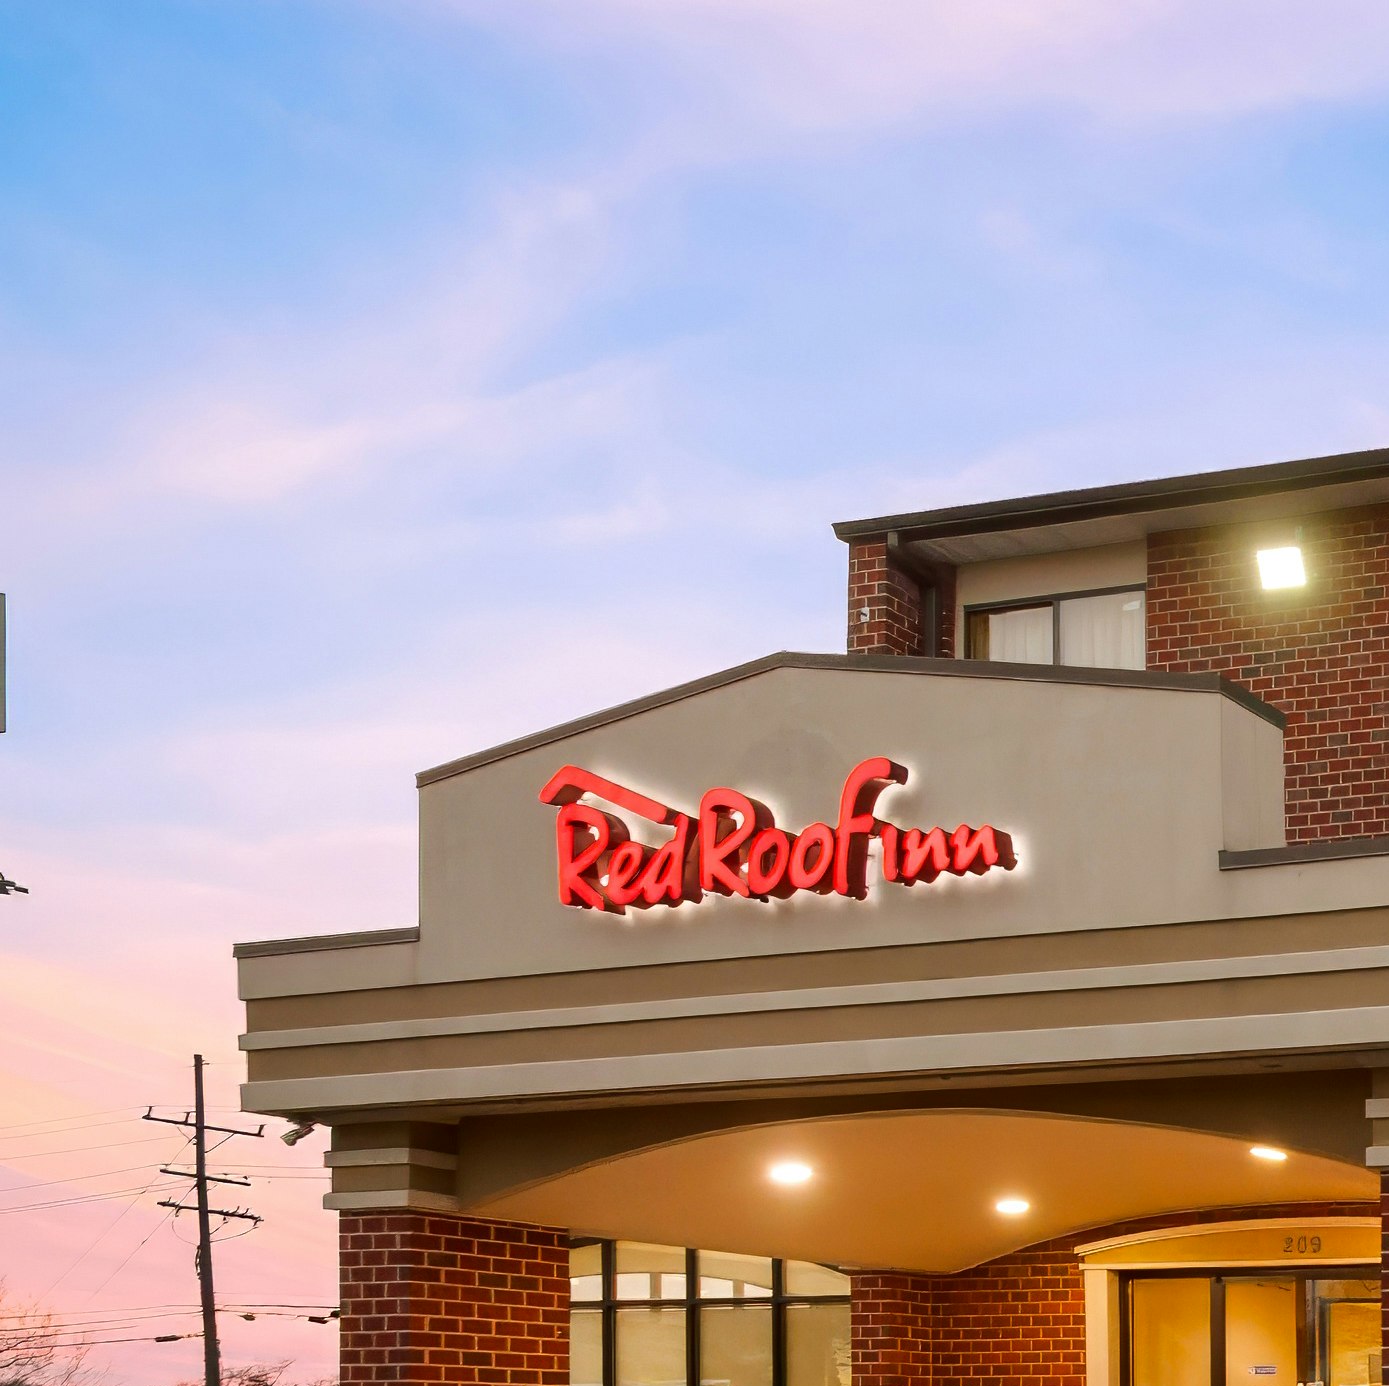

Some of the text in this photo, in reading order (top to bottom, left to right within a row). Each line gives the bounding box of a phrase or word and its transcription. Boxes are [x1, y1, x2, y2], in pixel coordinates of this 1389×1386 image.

[555, 802, 693, 912] Red
[700, 757, 900, 899] Roof
[1283, 1236, 1321, 1253] 209
